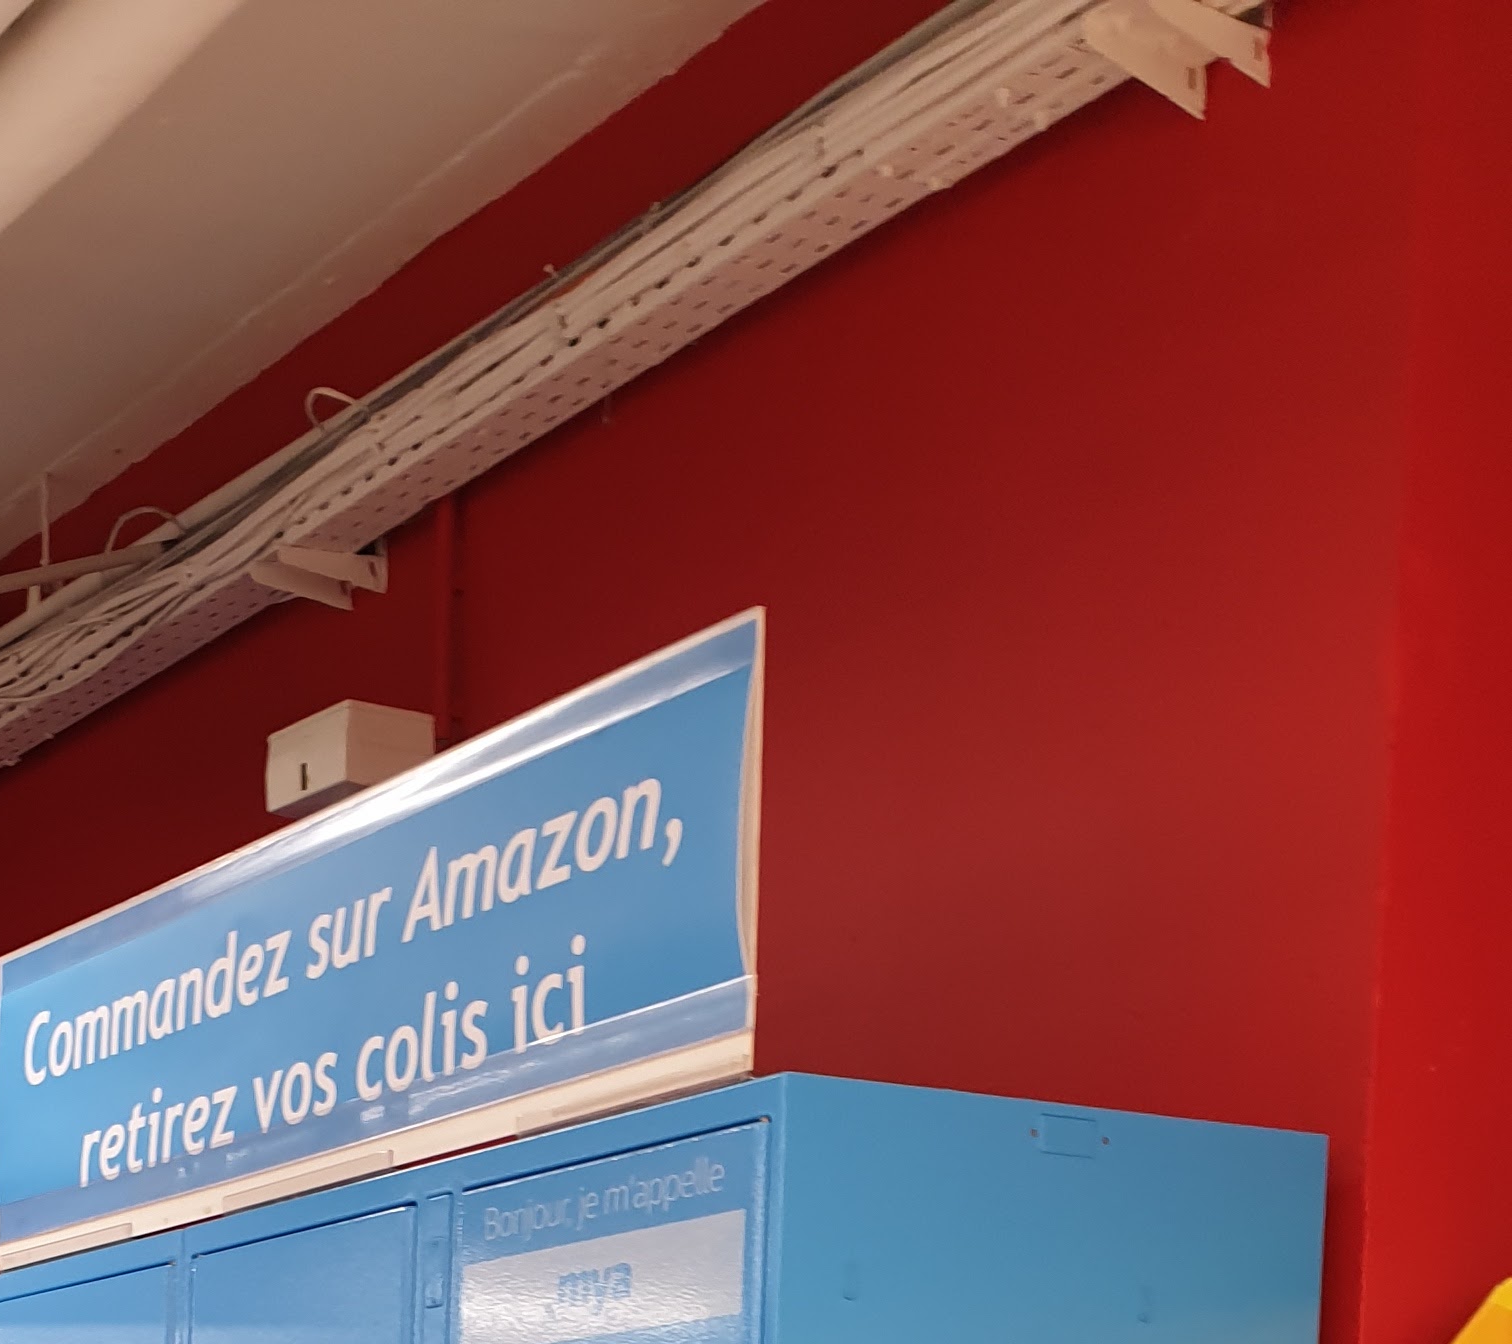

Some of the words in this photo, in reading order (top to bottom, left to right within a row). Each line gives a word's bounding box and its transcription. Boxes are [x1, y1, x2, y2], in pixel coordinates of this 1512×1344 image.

[23, 927, 291, 1086] Commandez
[304, 882, 393, 979] sur
[400, 777, 683, 943] Amazon,
[78, 1085, 236, 1188] retirez
[254, 1059, 338, 1134] vos
[355, 980, 489, 1101] colis
[511, 933, 587, 1055] ici
[576, 1186, 600, 1232] je
[603, 1155, 726, 1216] m'appelle
